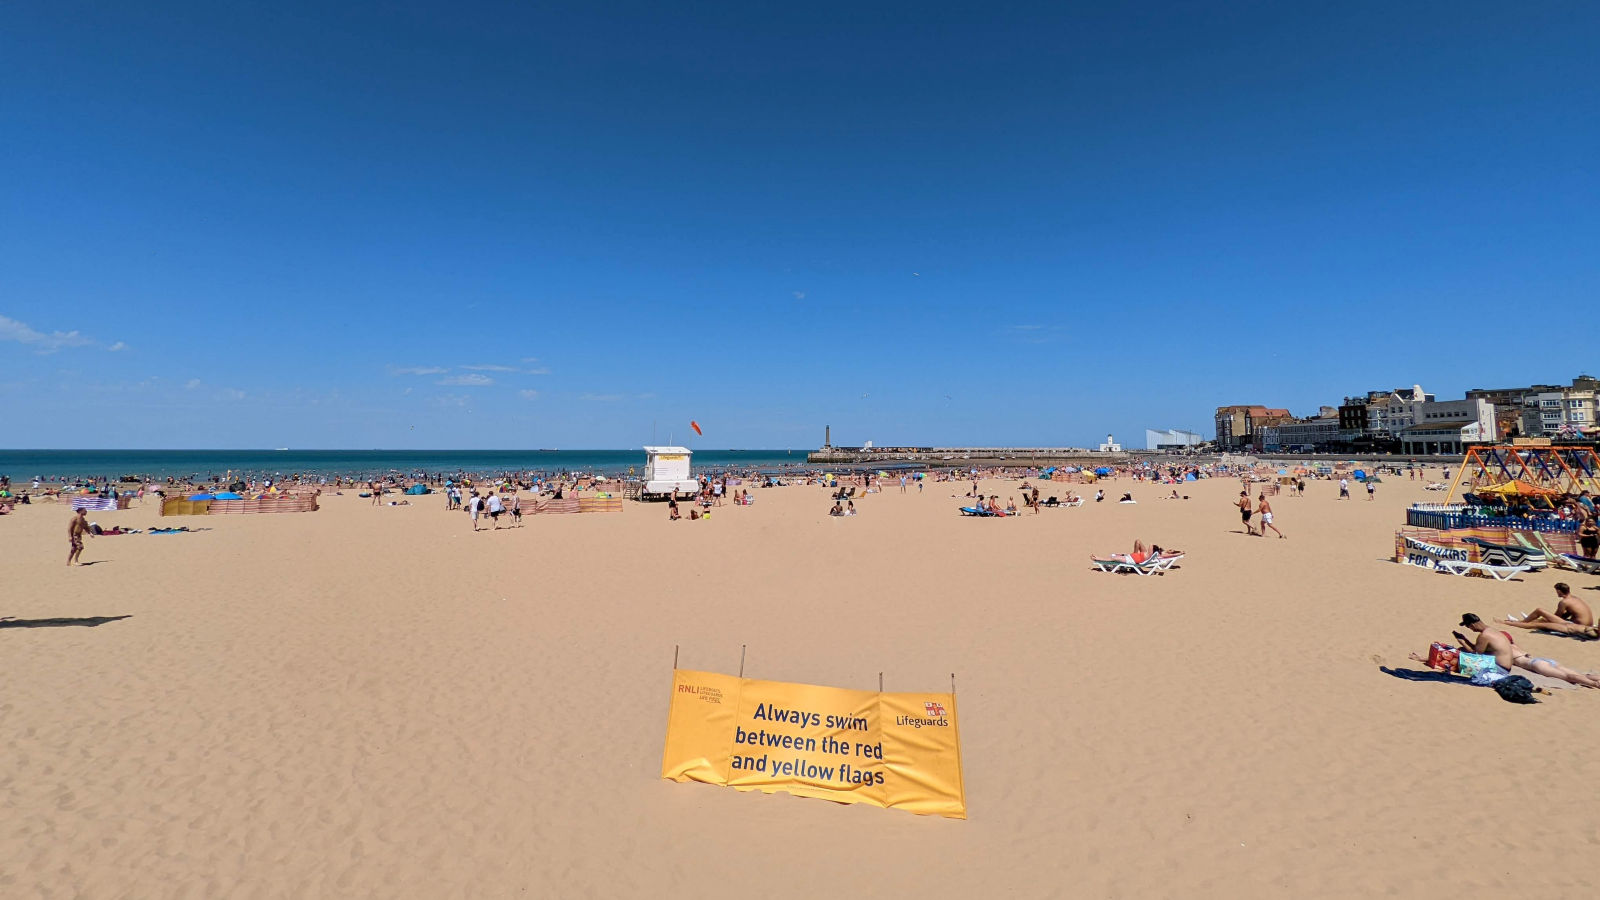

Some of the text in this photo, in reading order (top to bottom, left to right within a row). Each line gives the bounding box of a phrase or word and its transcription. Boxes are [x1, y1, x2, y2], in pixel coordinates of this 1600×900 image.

[1408, 553, 1429, 567] FOR
[678, 684, 700, 694] RNLI
[753, 703, 868, 731] Always swim
[896, 715, 949, 729] Lifeguards
[735, 726, 883, 760] between the red
[731, 754, 768, 772] and
[771, 758, 834, 781] yellow
[839, 763, 885, 787] flags
